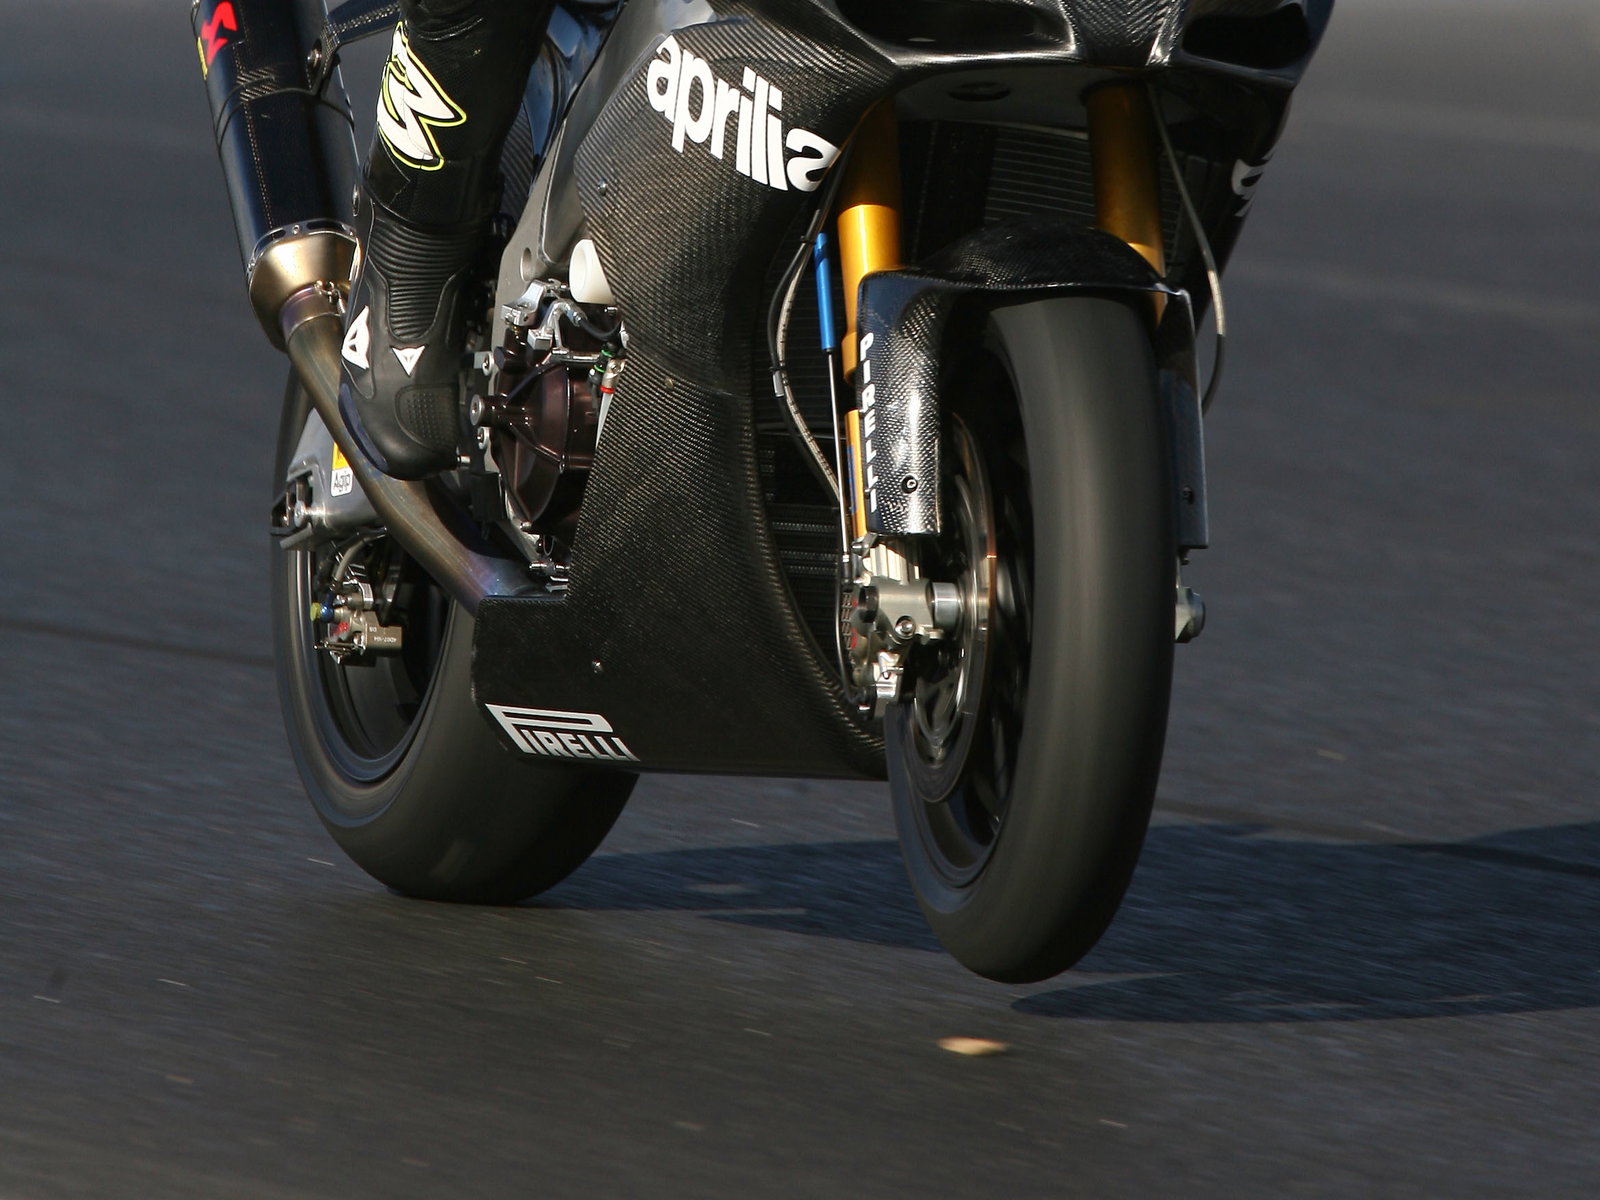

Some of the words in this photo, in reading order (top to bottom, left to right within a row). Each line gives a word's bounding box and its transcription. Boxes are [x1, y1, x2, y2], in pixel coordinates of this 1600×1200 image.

[646, 34, 842, 192] aprilia
[859, 332, 880, 513] PIRELLI
[484, 703, 642, 762] PIRELLI
